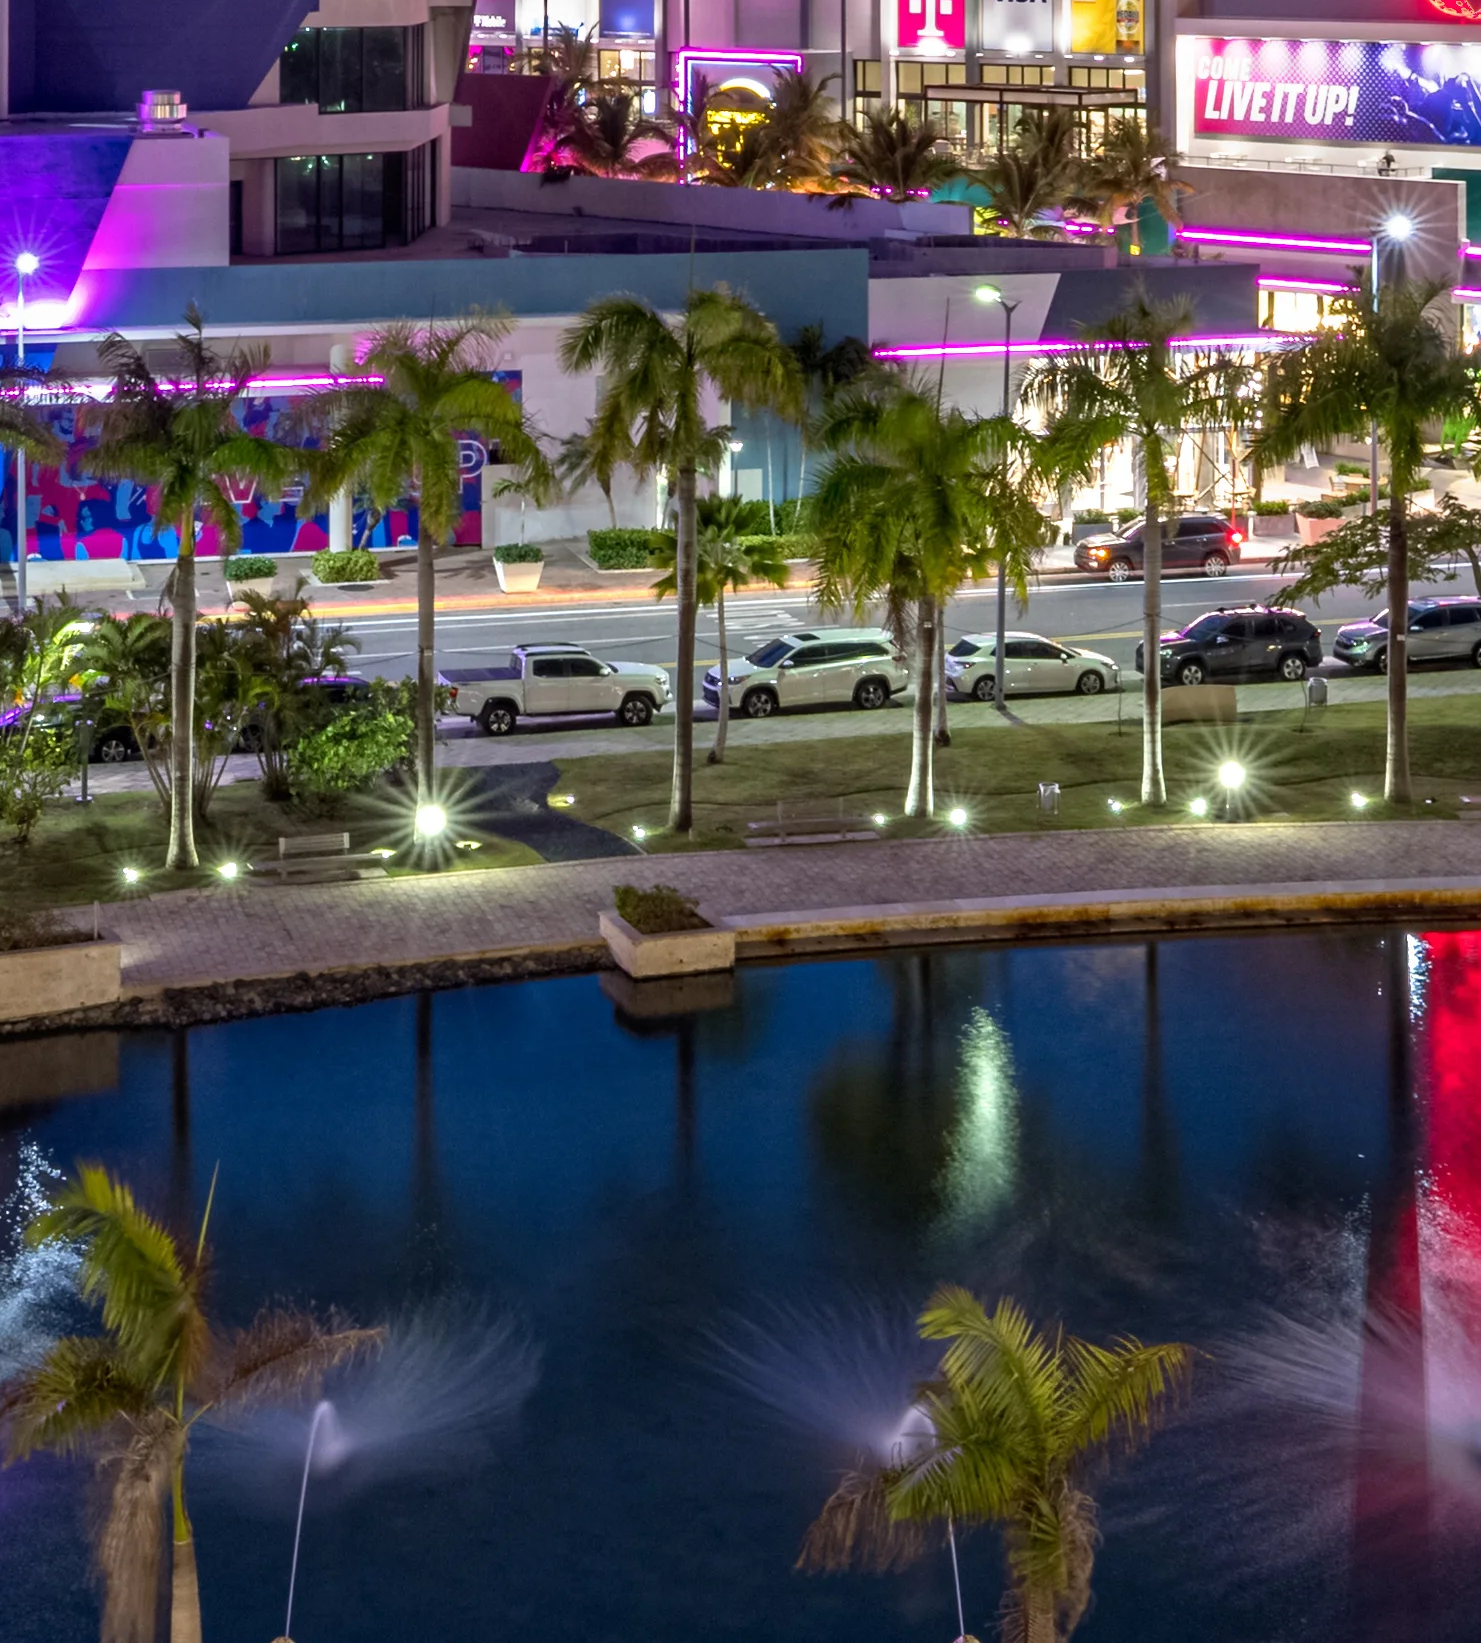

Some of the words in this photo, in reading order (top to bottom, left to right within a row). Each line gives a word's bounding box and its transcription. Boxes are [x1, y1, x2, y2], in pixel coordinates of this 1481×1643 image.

[1197, 56, 1253, 81] COME
[1204, 80, 1271, 122] LIVE
[1271, 82, 1306, 123] IT
[1303, 84, 1360, 126] UP!
